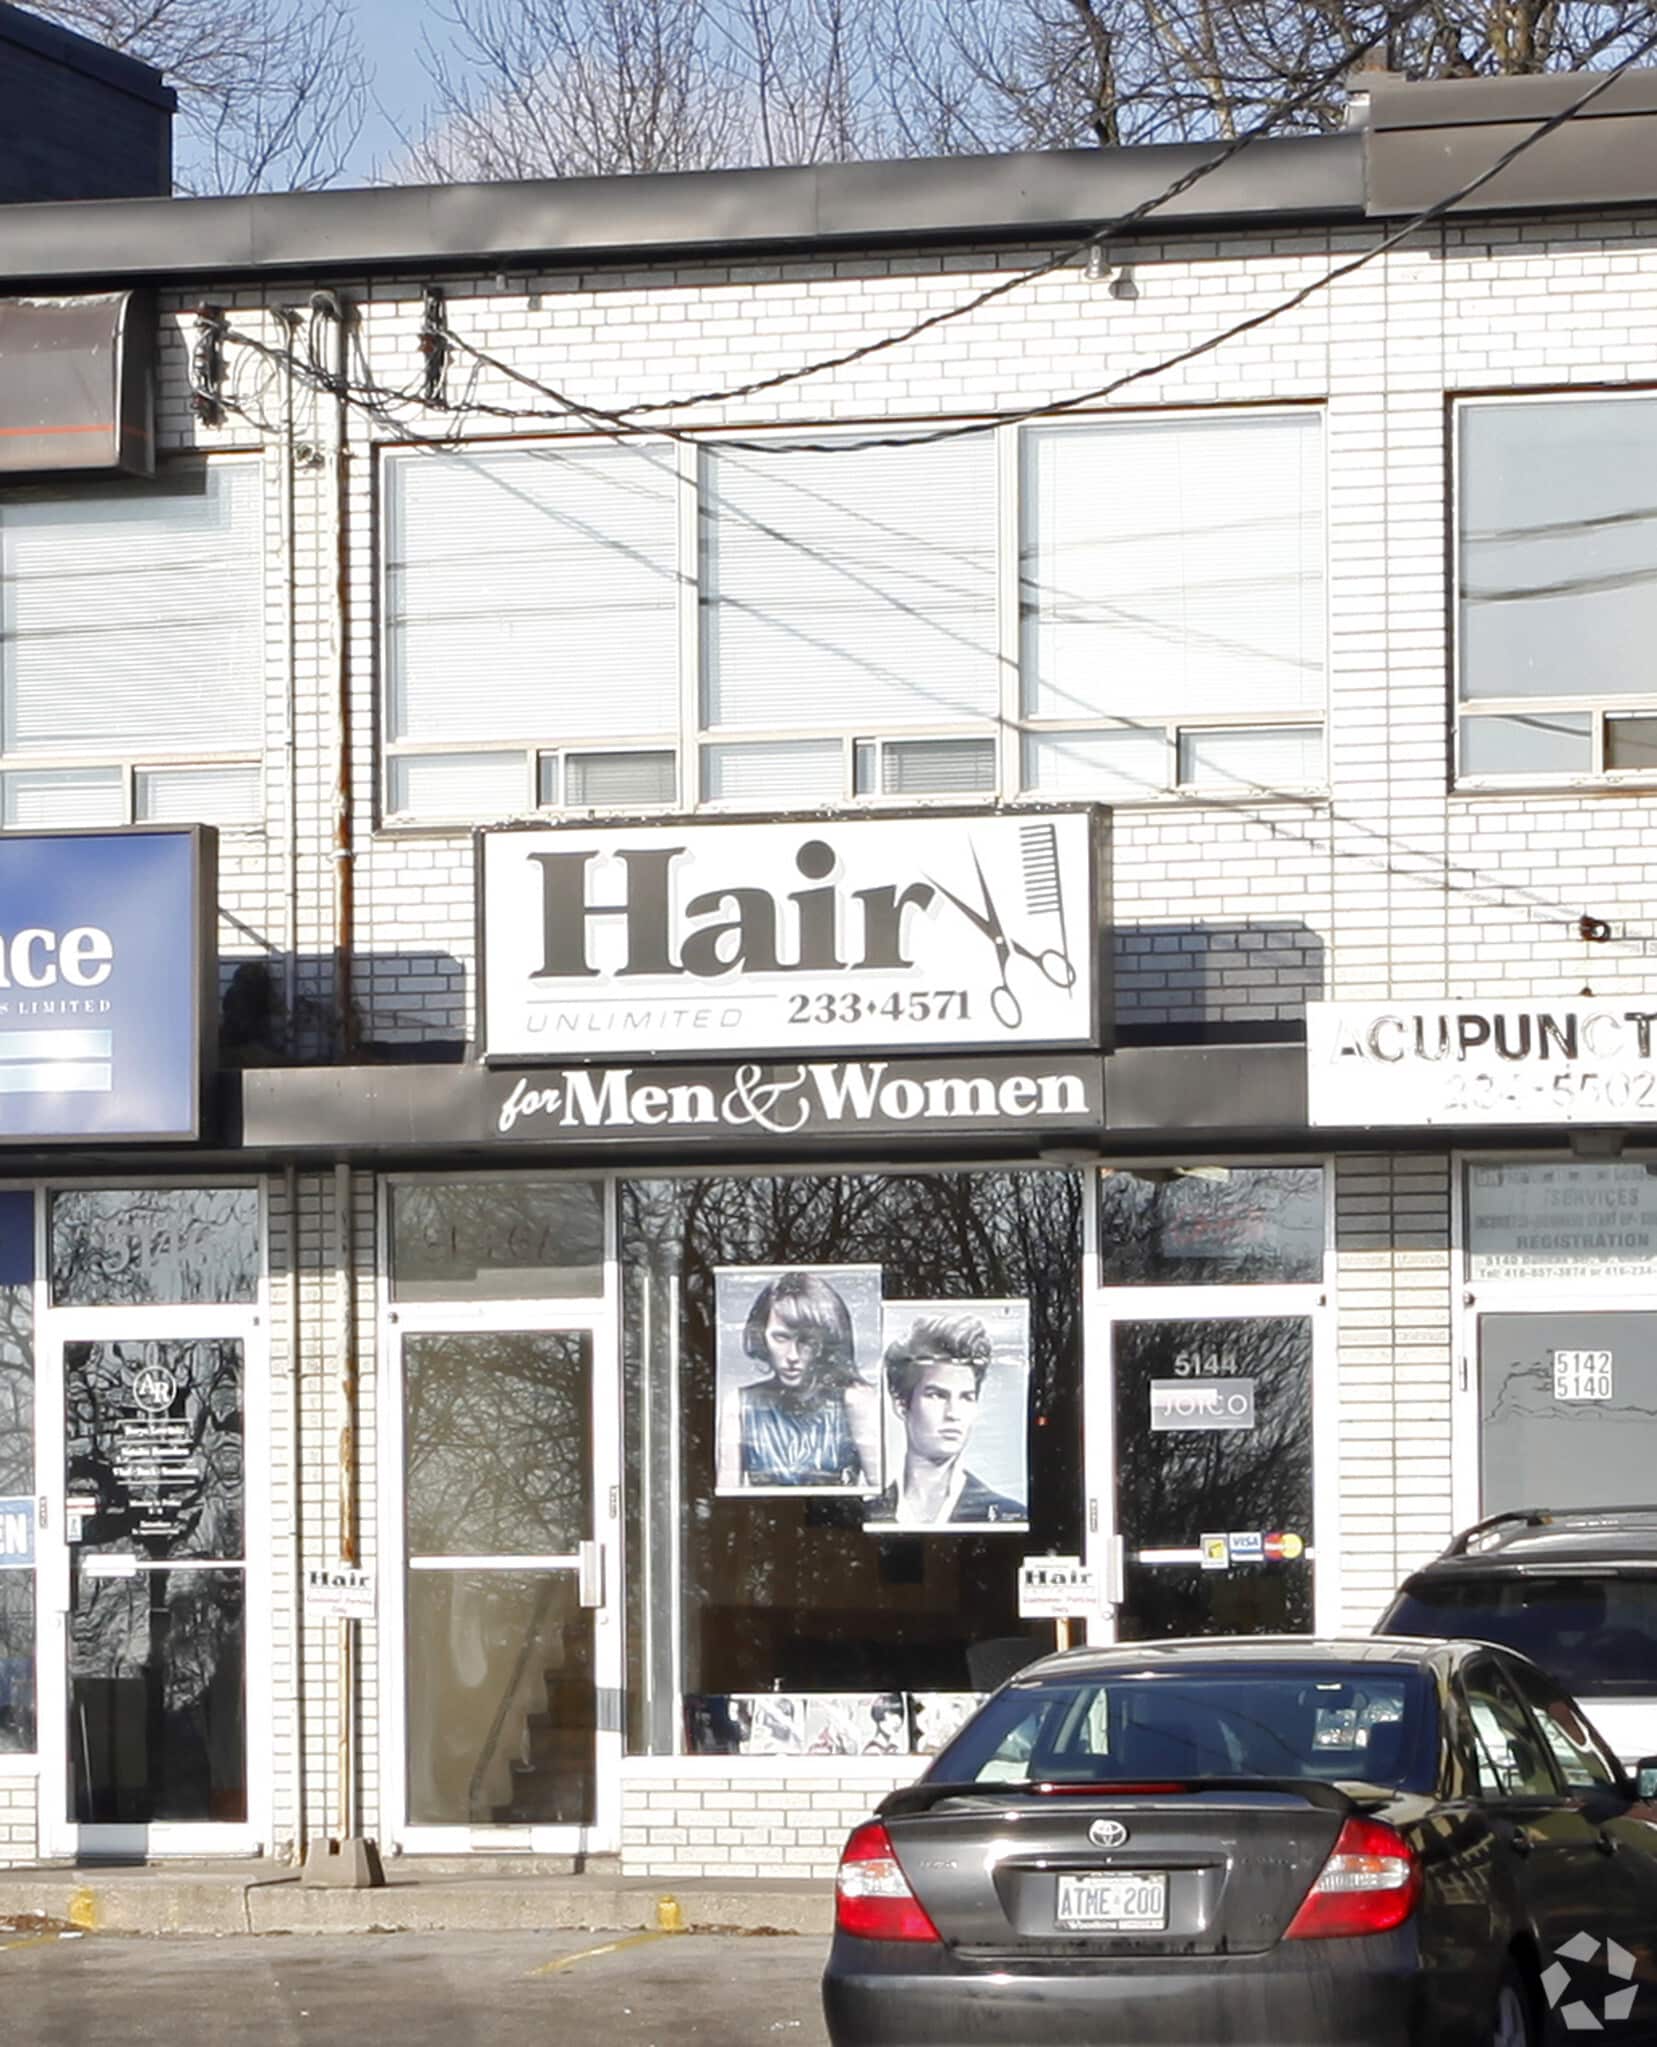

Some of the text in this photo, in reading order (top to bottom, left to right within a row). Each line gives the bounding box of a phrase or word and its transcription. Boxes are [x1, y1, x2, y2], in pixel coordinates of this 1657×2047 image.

[526, 840, 937, 979] Hair
[19, 999, 110, 1014] LIMITED
[526, 1008, 743, 1033] UNLIMITED
[499, 1063, 1089, 1133] for Men & Women
[1174, 1351, 1238, 1376] 5144
[1557, 1352, 1610, 1374] 5142
[1557, 1376, 1610, 1397] 5140
[0, 1512, 28, 1555] N
[310, 1571, 370, 1586] Hair
[1025, 1570, 1093, 1585] Hair
[1124, 1887, 1161, 1914] 200
